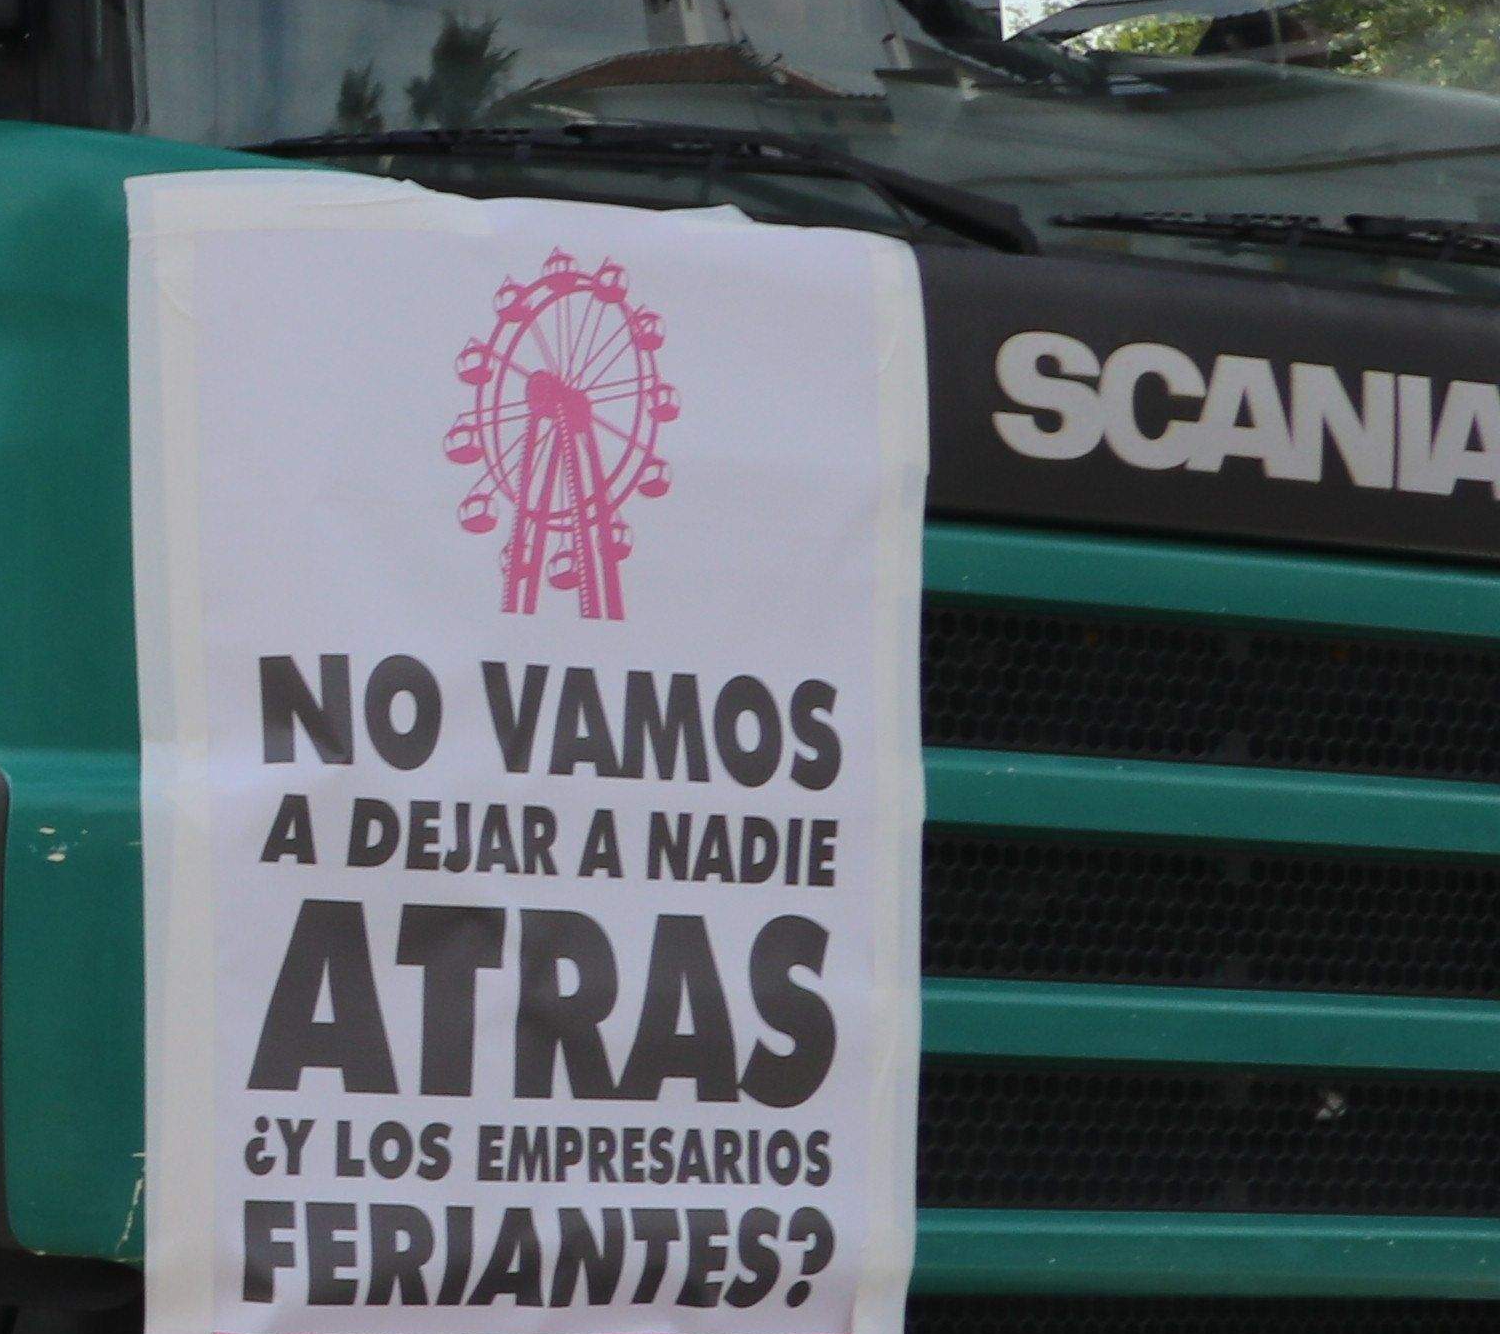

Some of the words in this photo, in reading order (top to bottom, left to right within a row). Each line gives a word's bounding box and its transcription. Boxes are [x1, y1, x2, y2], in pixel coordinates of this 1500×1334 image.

[992, 330, 1500, 501] SCANIA
[259, 652, 442, 771] NO
[481, 661, 843, 791] VAMOS
[260, 794, 317, 865] A
[347, 797, 558, 877] DEJAR
[578, 809, 623, 878] A
[647, 812, 840, 888] NADIE
[246, 898, 838, 1109] ATRAS
[244, 1116, 315, 1177] ¿Y
[334, 1121, 452, 1180] LOS
[476, 1124, 833, 1188] EMPRESARIOS
[241, 1199, 837, 1310] FERIANTES?
